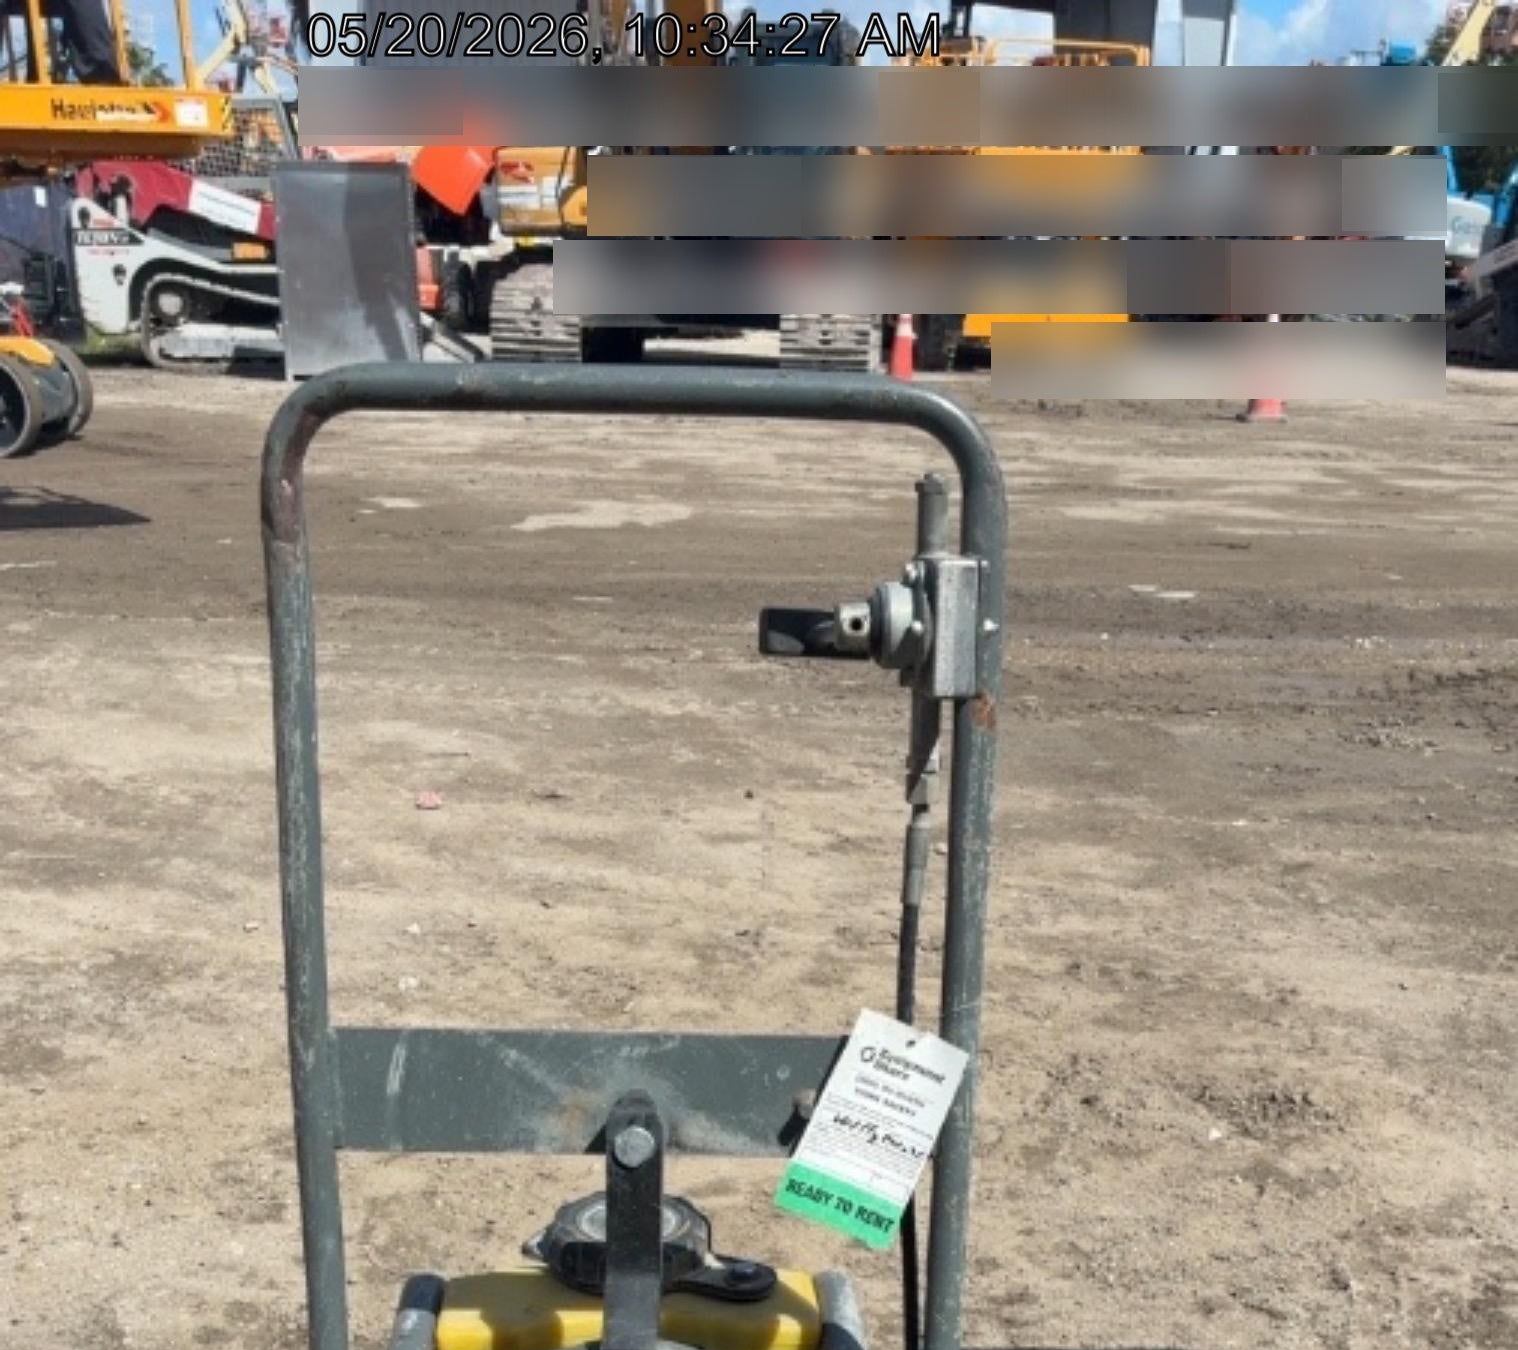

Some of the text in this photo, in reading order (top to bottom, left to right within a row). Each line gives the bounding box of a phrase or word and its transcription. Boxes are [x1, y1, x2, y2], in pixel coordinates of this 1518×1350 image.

[785, 1179, 895, 1233] READY TO RENT
